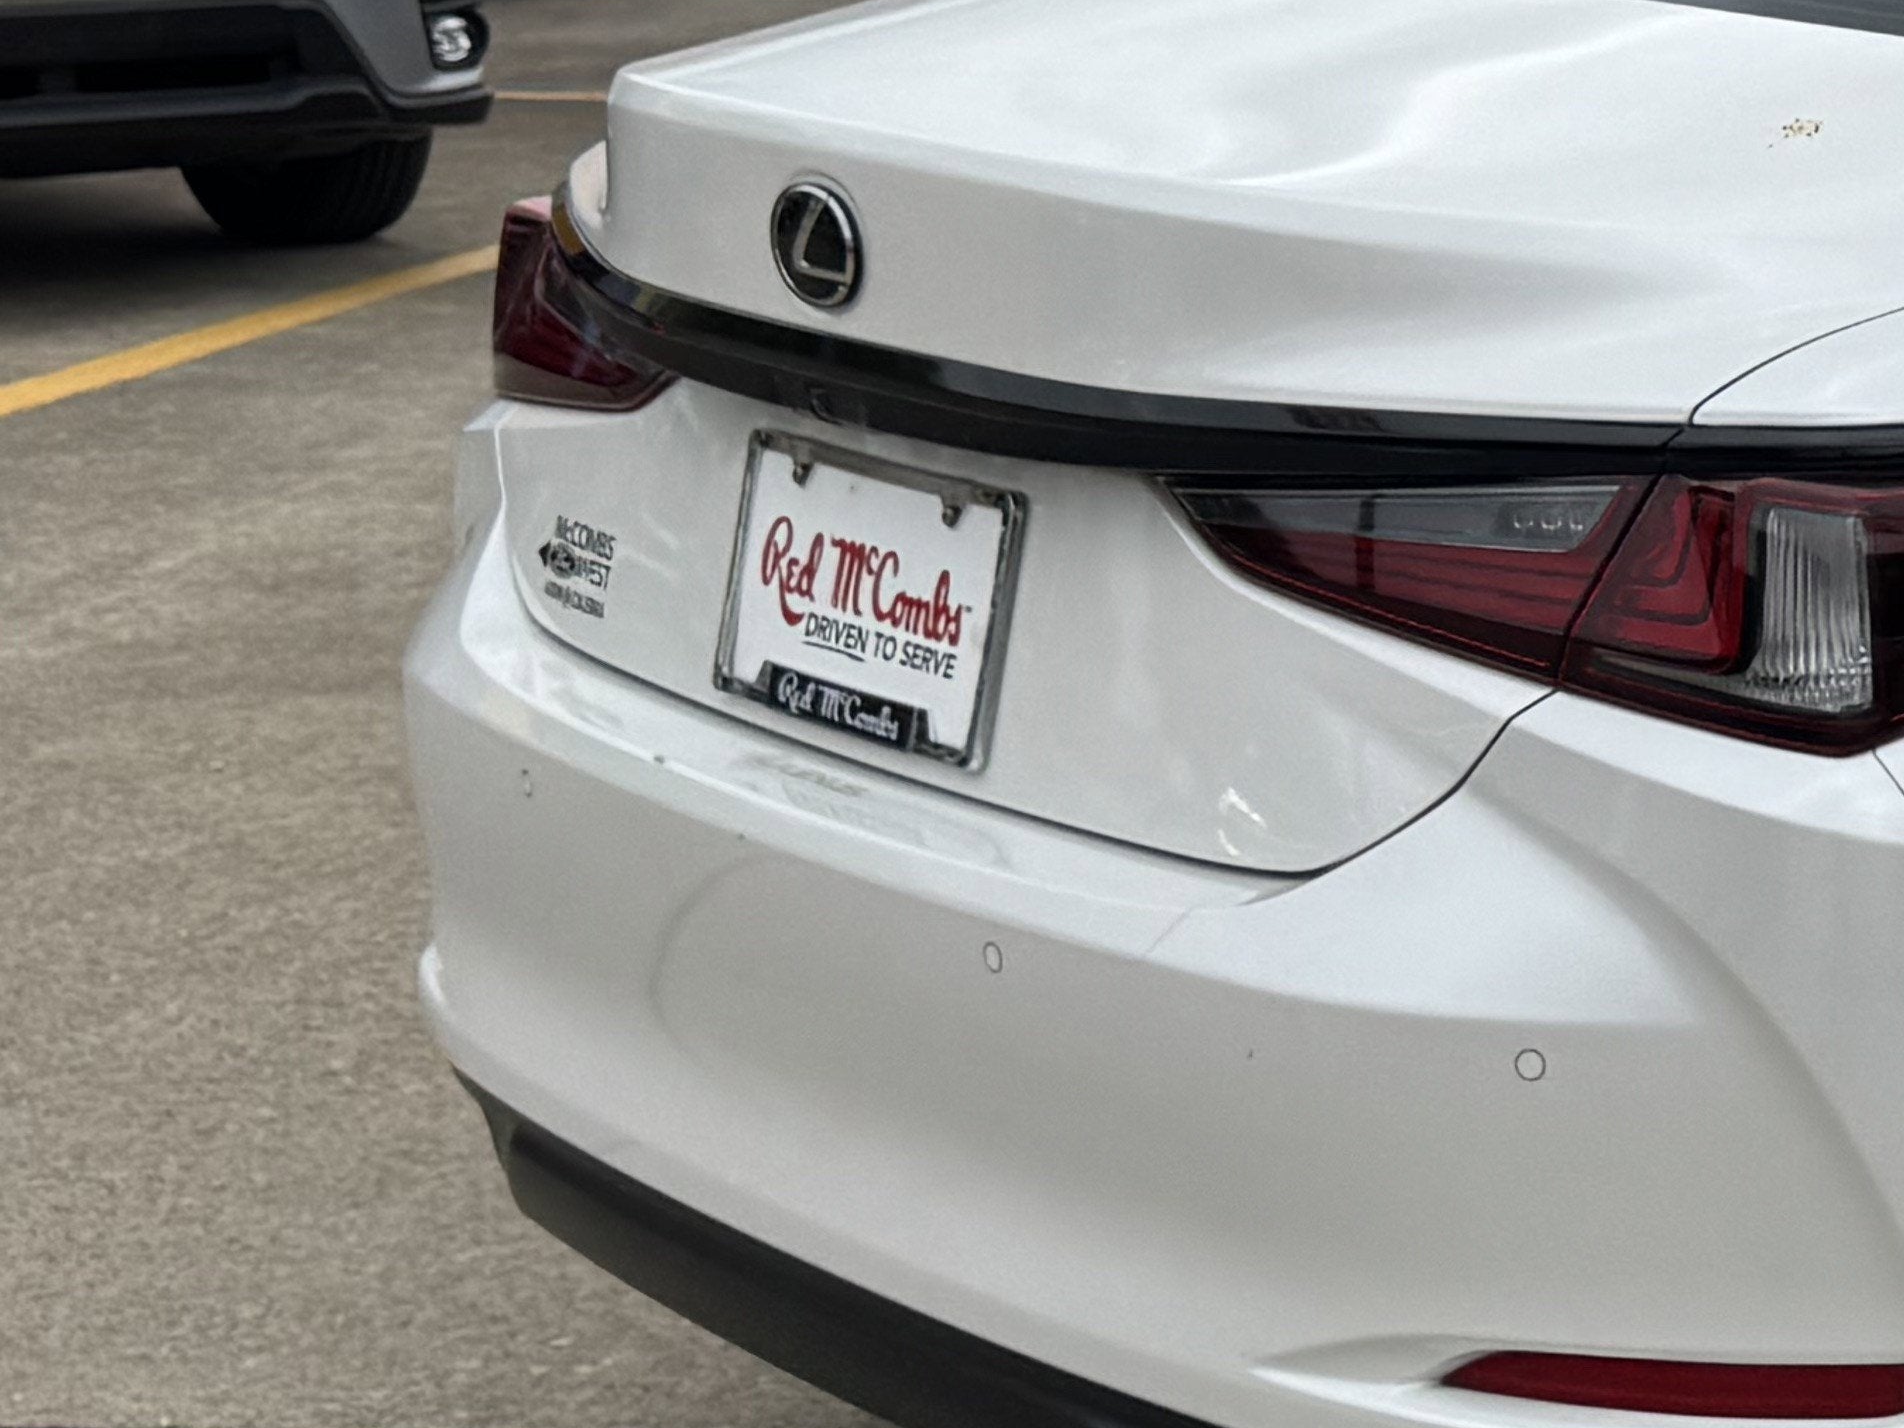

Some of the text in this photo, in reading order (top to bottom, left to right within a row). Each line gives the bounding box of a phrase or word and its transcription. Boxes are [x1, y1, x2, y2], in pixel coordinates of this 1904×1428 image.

[761, 515, 962, 647] Red McCombs
[804, 612, 957, 679] DRIVEN TO SERVE
